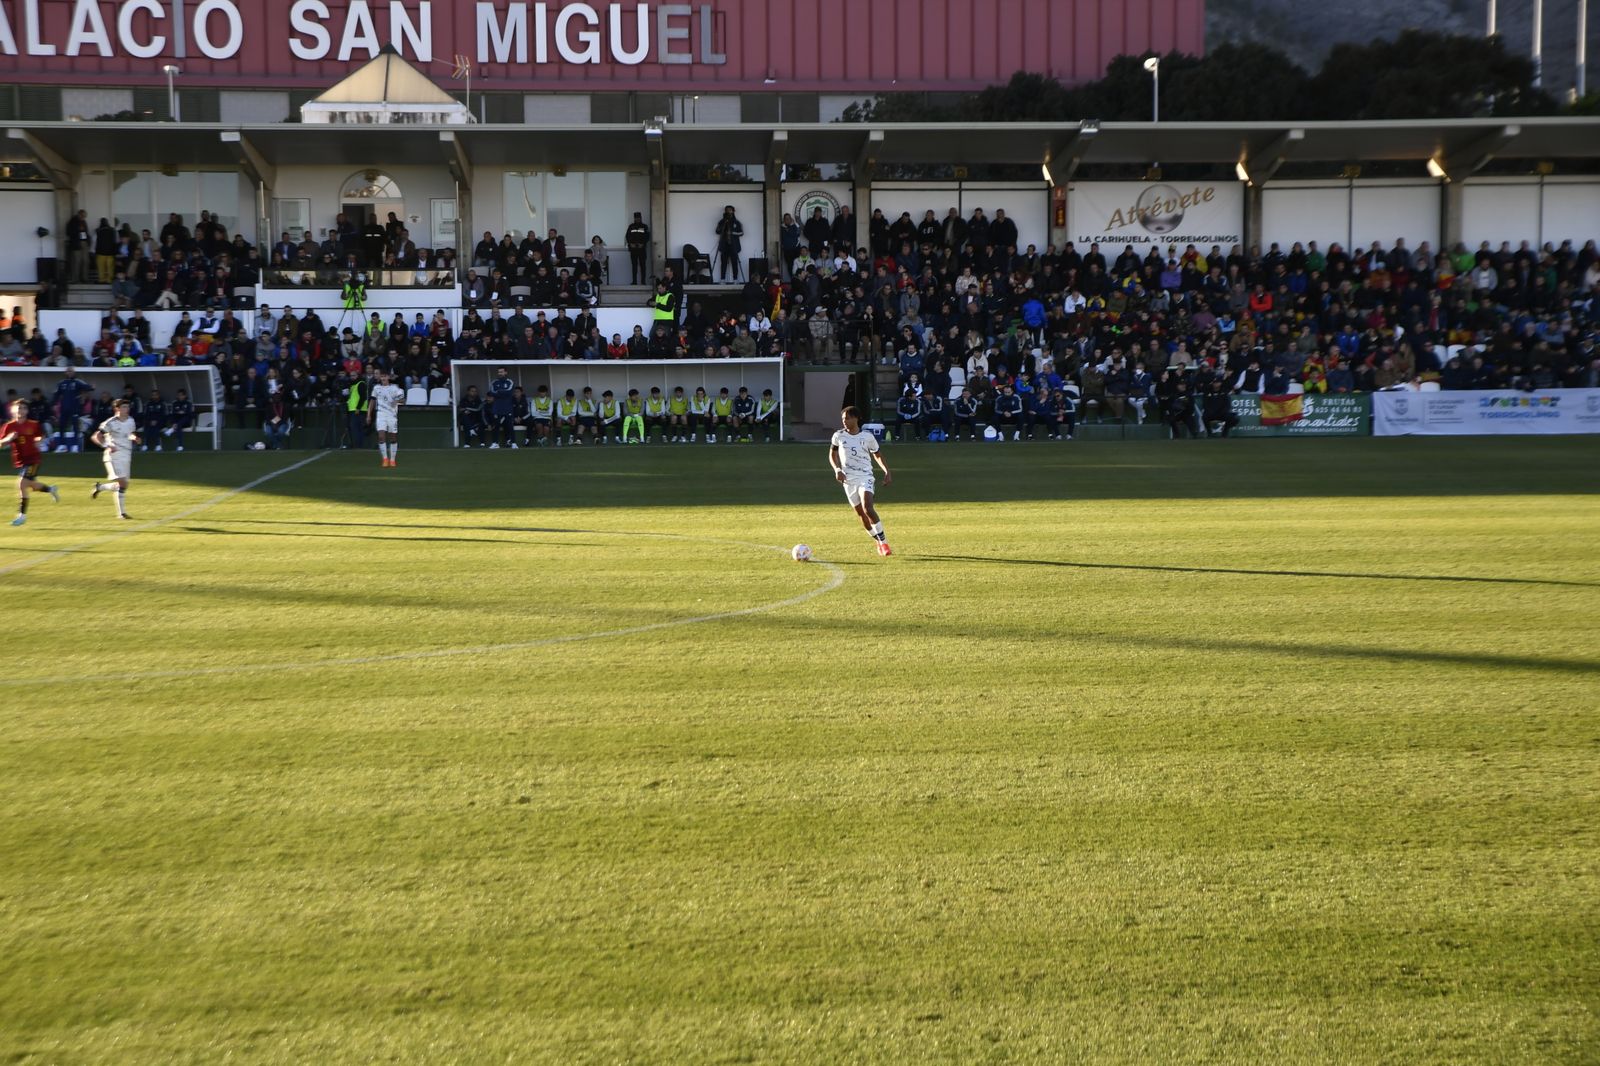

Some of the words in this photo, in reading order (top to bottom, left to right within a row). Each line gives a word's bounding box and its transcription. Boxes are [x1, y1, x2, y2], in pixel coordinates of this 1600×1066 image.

[288, 0, 432, 62] SAN
[476, 2, 726, 64] MIGUEL
[1104, 186, 1216, 232] Atrévete
[1079, 235, 1092, 243] LA
[1094, 235, 1151, 243] CARIHUELA
[1160, 235, 1239, 243] TORREMOLINOS
[1322, 398, 1356, 406] FRUTAS
[851, 447, 857, 456] 5
